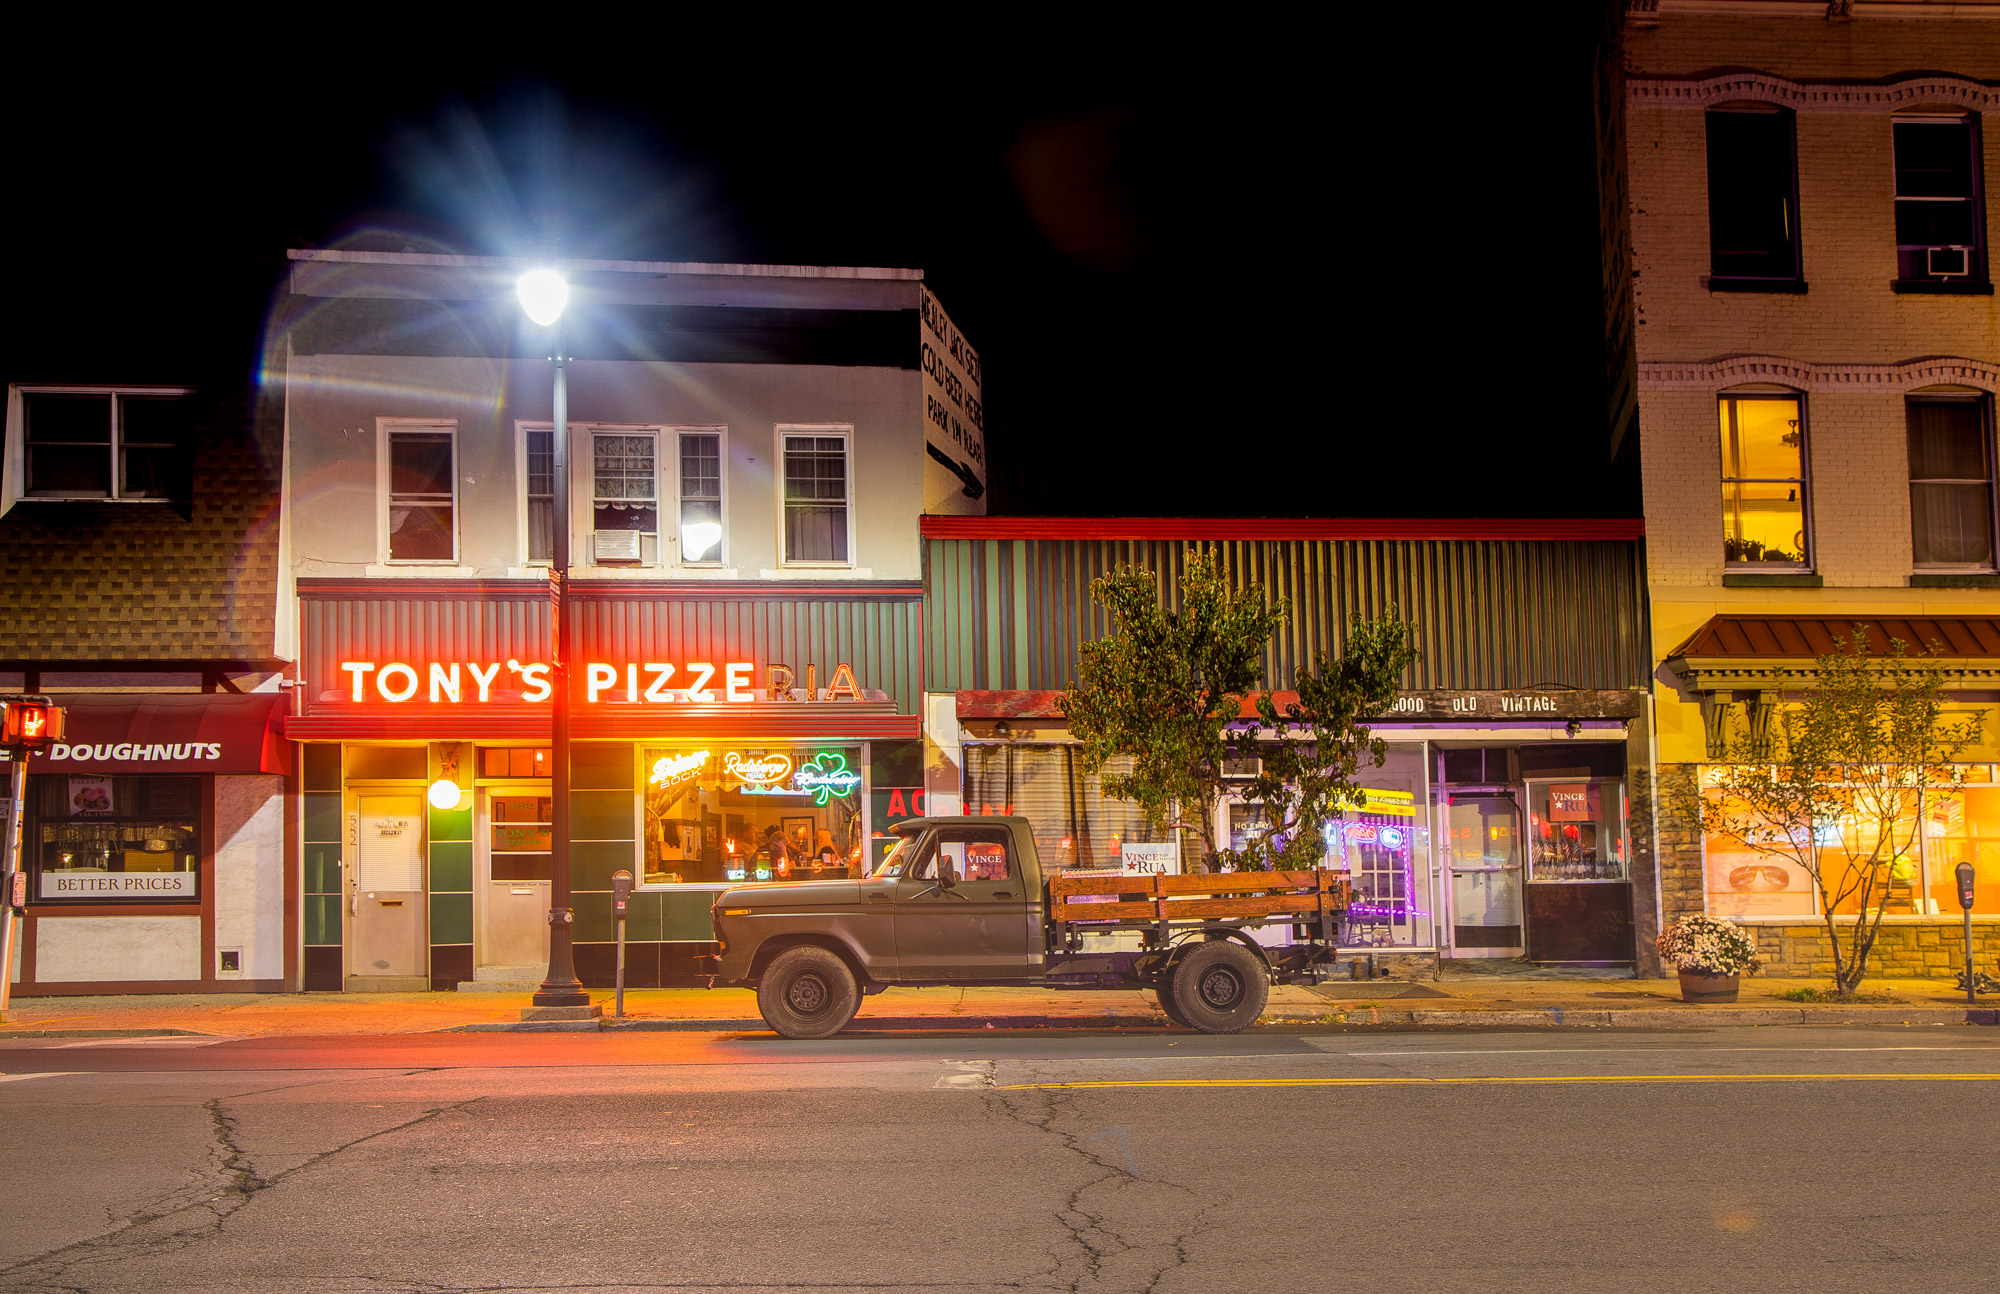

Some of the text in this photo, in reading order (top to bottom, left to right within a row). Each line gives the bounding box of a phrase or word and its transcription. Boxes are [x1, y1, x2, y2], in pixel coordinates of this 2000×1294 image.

[921, 342, 983, 432] COLD BEER HERE
[928, 394, 983, 468] PARK IN REAR
[341, 659, 865, 702] TONY'S PIZZERIA
[1453, 697, 1477, 712] OLD
[1501, 697, 1558, 712] VINTAGE
[50, 743, 221, 761] DOUGHNUTS
[724, 752, 788, 778] Radeberger
[660, 767, 702, 789] BOCK
[794, 772, 861, 786] Budweiser
[1552, 792, 1585, 801] VINCE
[509, 802, 535, 810] 582
[1564, 800, 1593, 812] RUA
[494, 828, 550, 838] TONY'S
[1234, 821, 1270, 832] NO ENTRY
[966, 855, 1002, 863] VINCE
[1125, 852, 1159, 861] VINCE
[1137, 861, 1168, 873] RUA
[57, 877, 182, 891] BETTER PRICES
